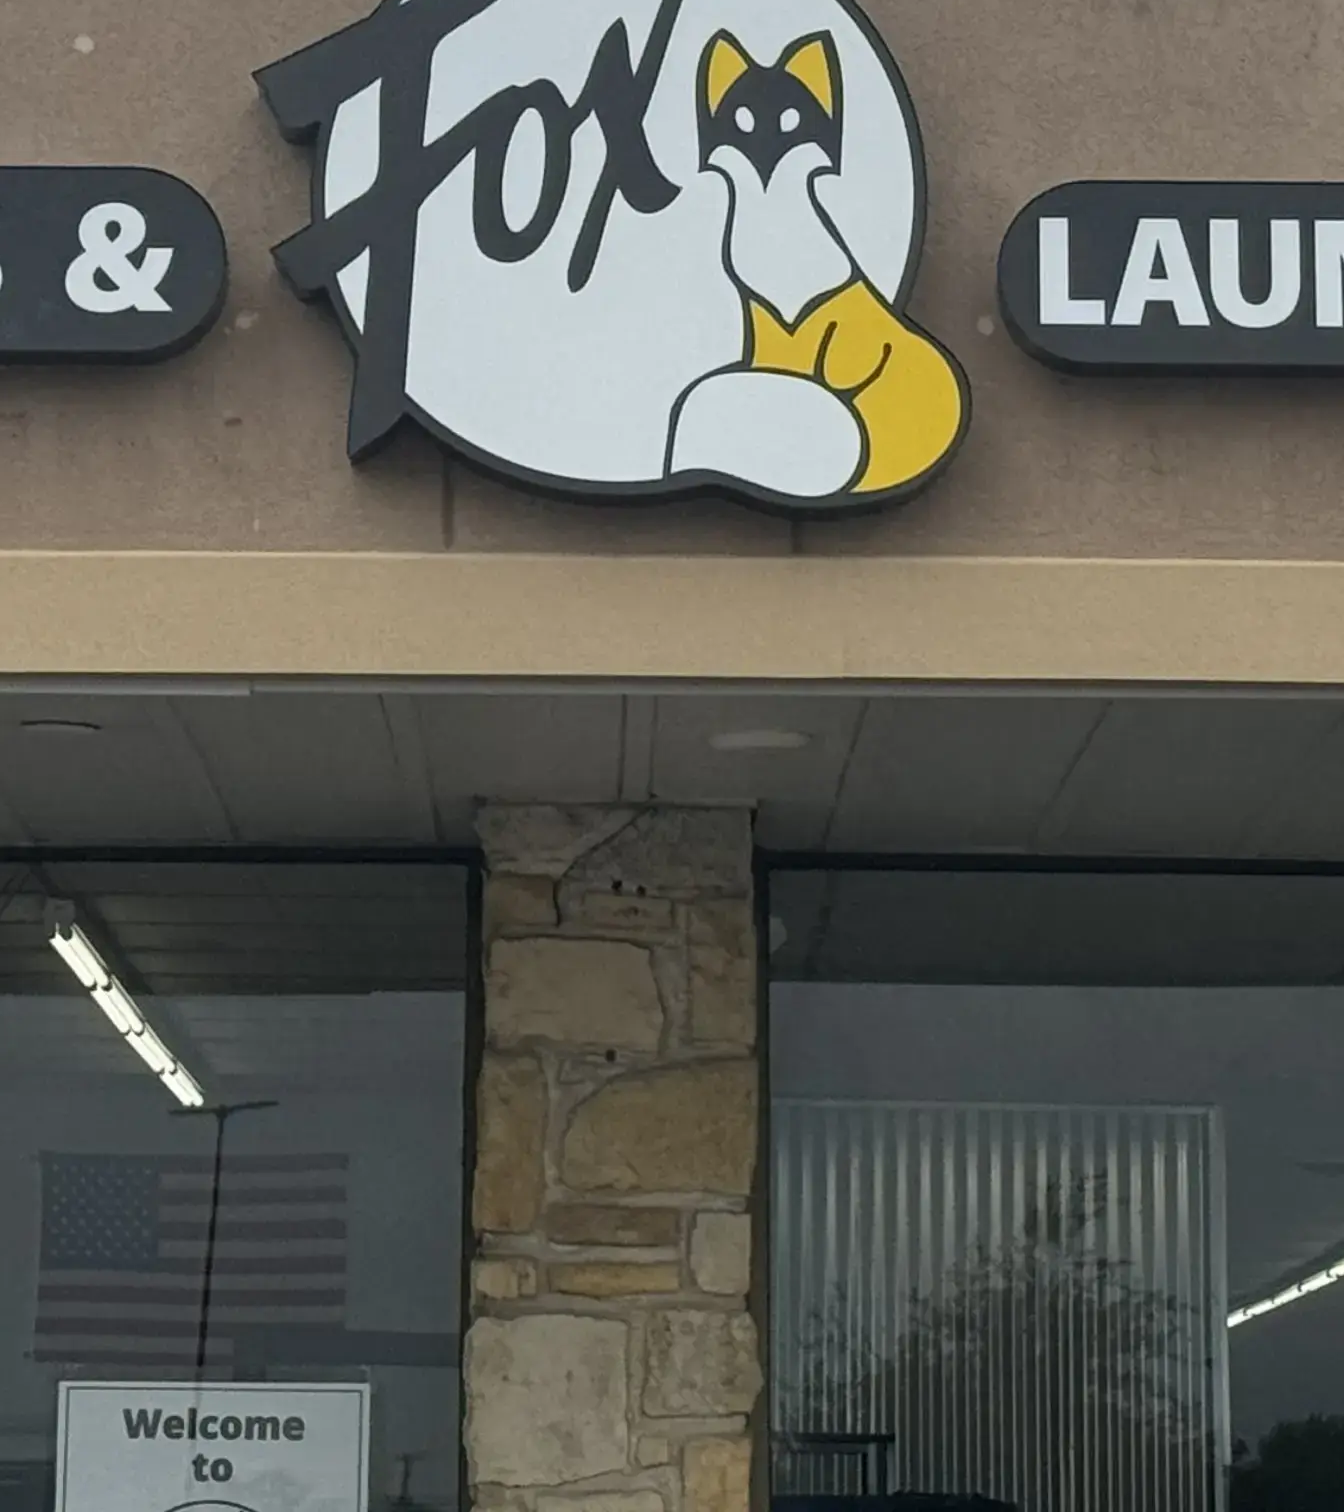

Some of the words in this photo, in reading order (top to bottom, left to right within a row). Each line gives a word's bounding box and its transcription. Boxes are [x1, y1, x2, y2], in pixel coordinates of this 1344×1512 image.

[63, 201, 174, 314] &
[122, 1407, 306, 1440] Welcome
[192, 1453, 234, 1482] to
